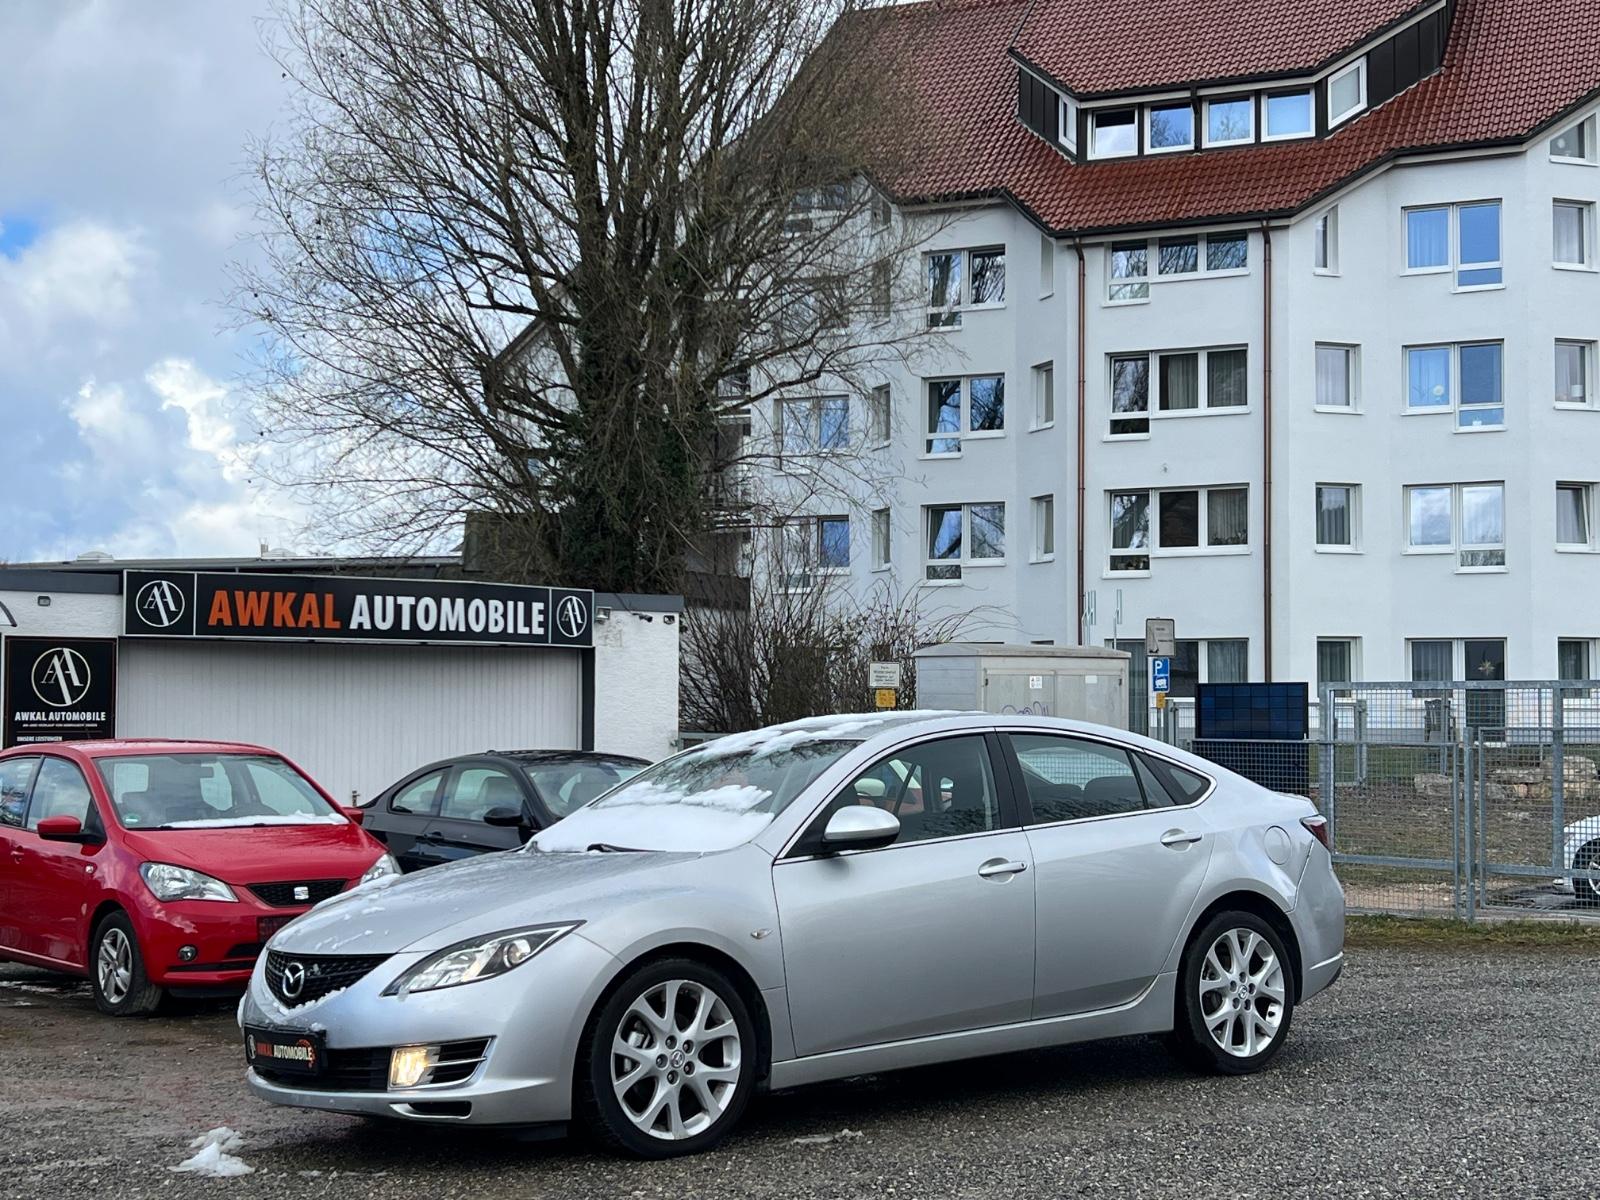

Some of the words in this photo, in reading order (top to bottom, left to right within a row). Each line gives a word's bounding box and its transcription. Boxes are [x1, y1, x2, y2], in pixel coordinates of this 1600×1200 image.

[207, 590, 341, 629] AWKAL
[349, 594, 546, 636] AUTOMOBILE
[1154, 660, 1163, 675] P
[14, 711, 47, 721] AWKAL
[48, 711, 107, 721] AUTOMOBILE
[273, 1044, 313, 1061] AUTOMOBILE
